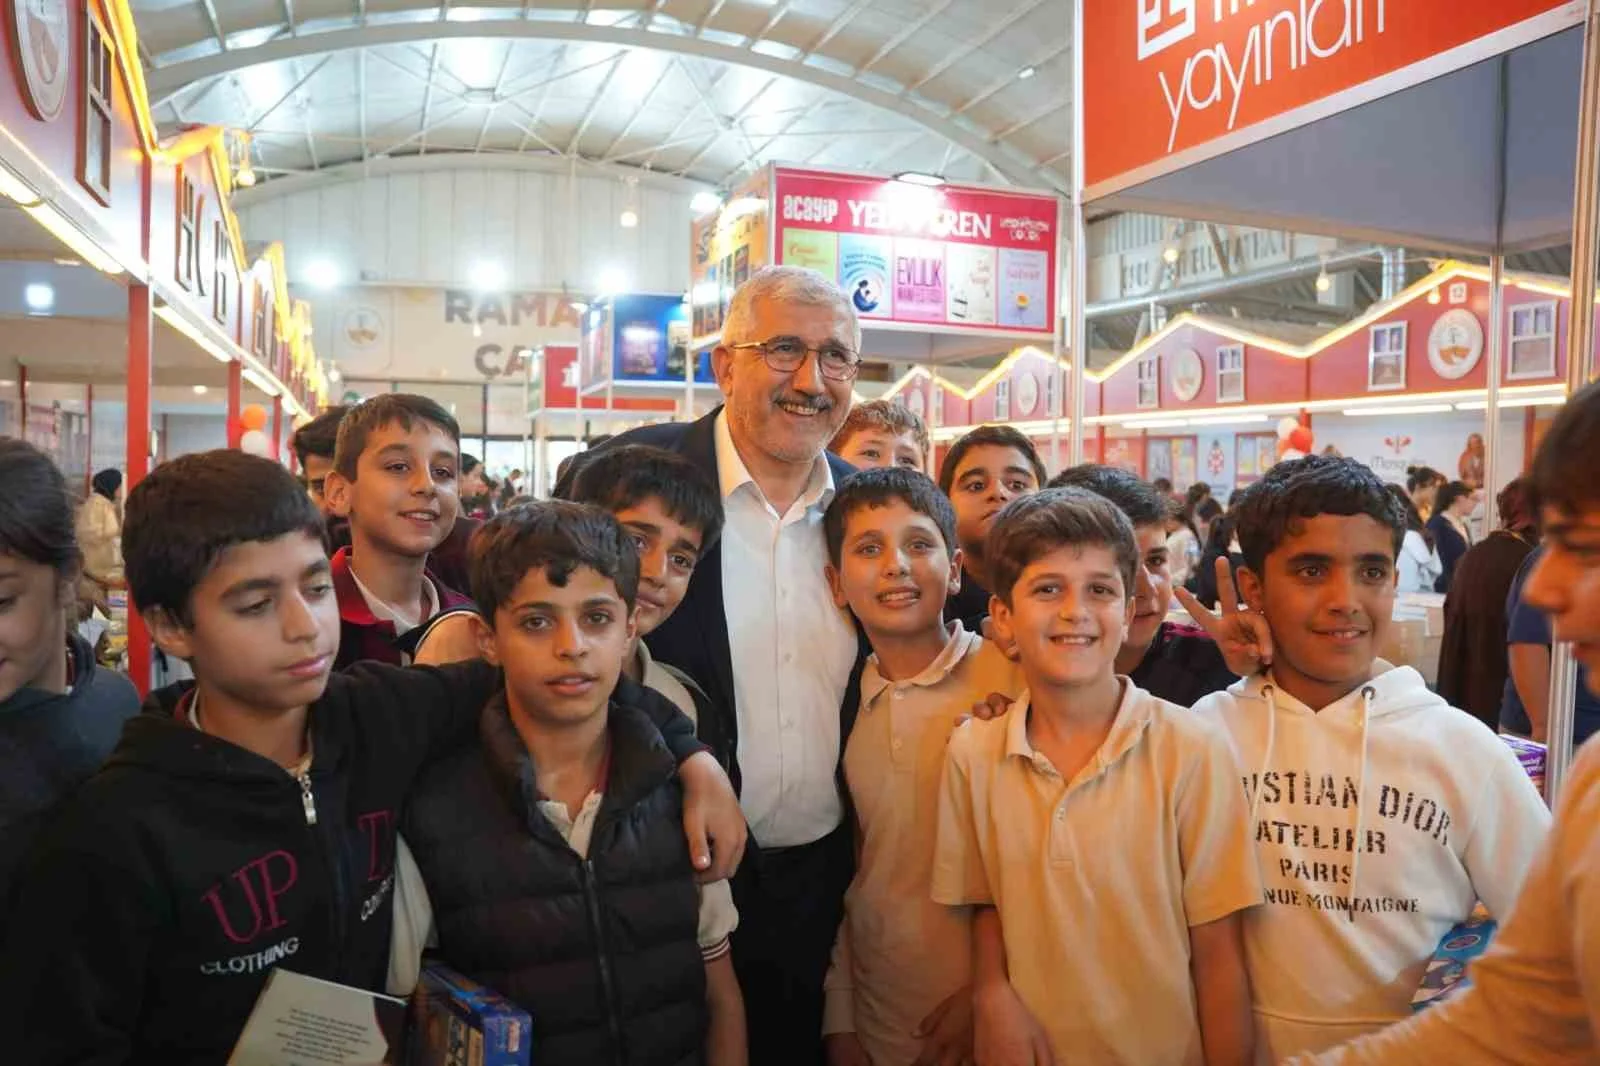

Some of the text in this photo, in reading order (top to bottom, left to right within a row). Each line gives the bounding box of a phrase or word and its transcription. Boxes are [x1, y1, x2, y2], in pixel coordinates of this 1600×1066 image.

[848, 199, 992, 239] YEREN
[1242, 772, 1451, 846] ISTIAN DIOR
[1279, 858, 1352, 885] PARIS
[201, 849, 298, 944] UP
[200, 937, 300, 976] CLOTHING
